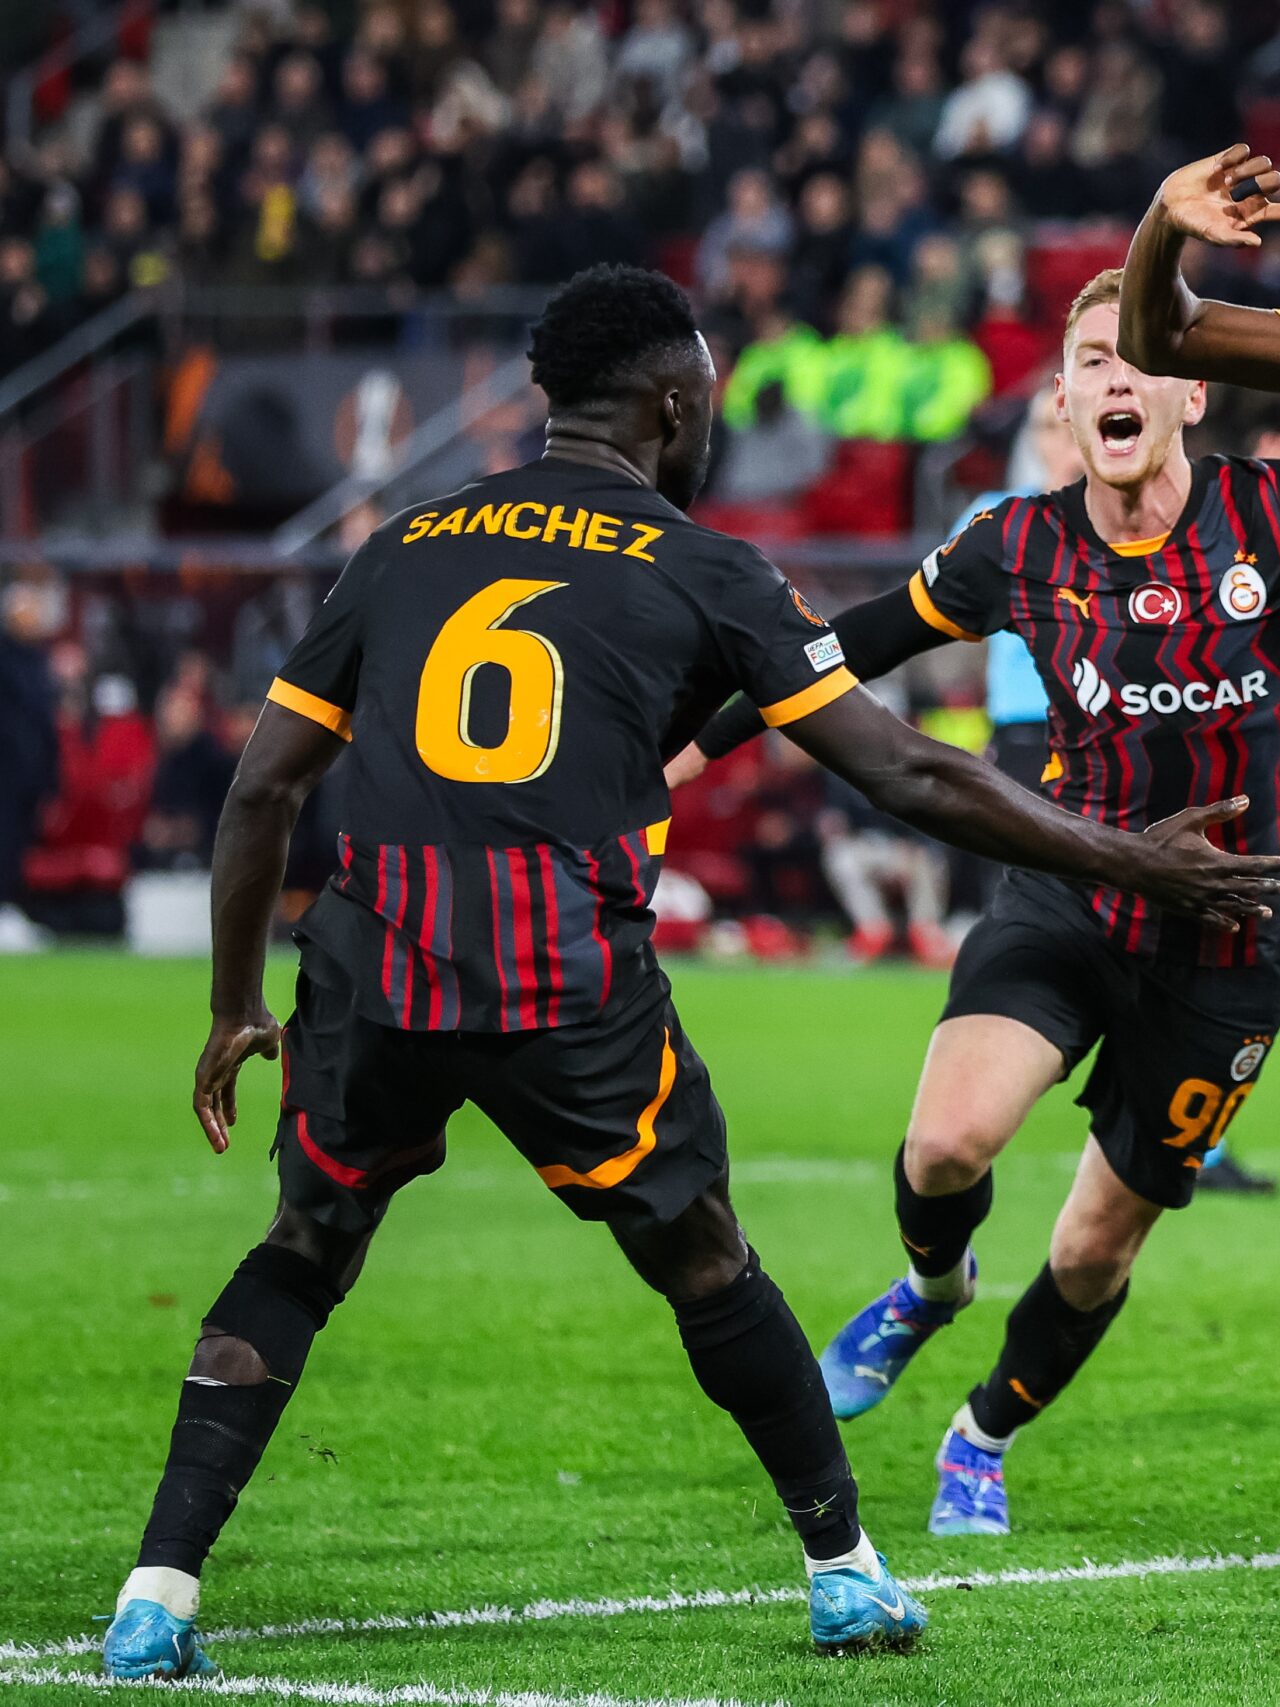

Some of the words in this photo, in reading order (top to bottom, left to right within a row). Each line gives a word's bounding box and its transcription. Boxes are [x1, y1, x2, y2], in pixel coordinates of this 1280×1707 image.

[403, 502, 664, 563] SANCHEZ
[807, 642, 823, 652] UEFA
[415, 578, 569, 784] 6
[1120, 670, 1269, 716] SOCAR
